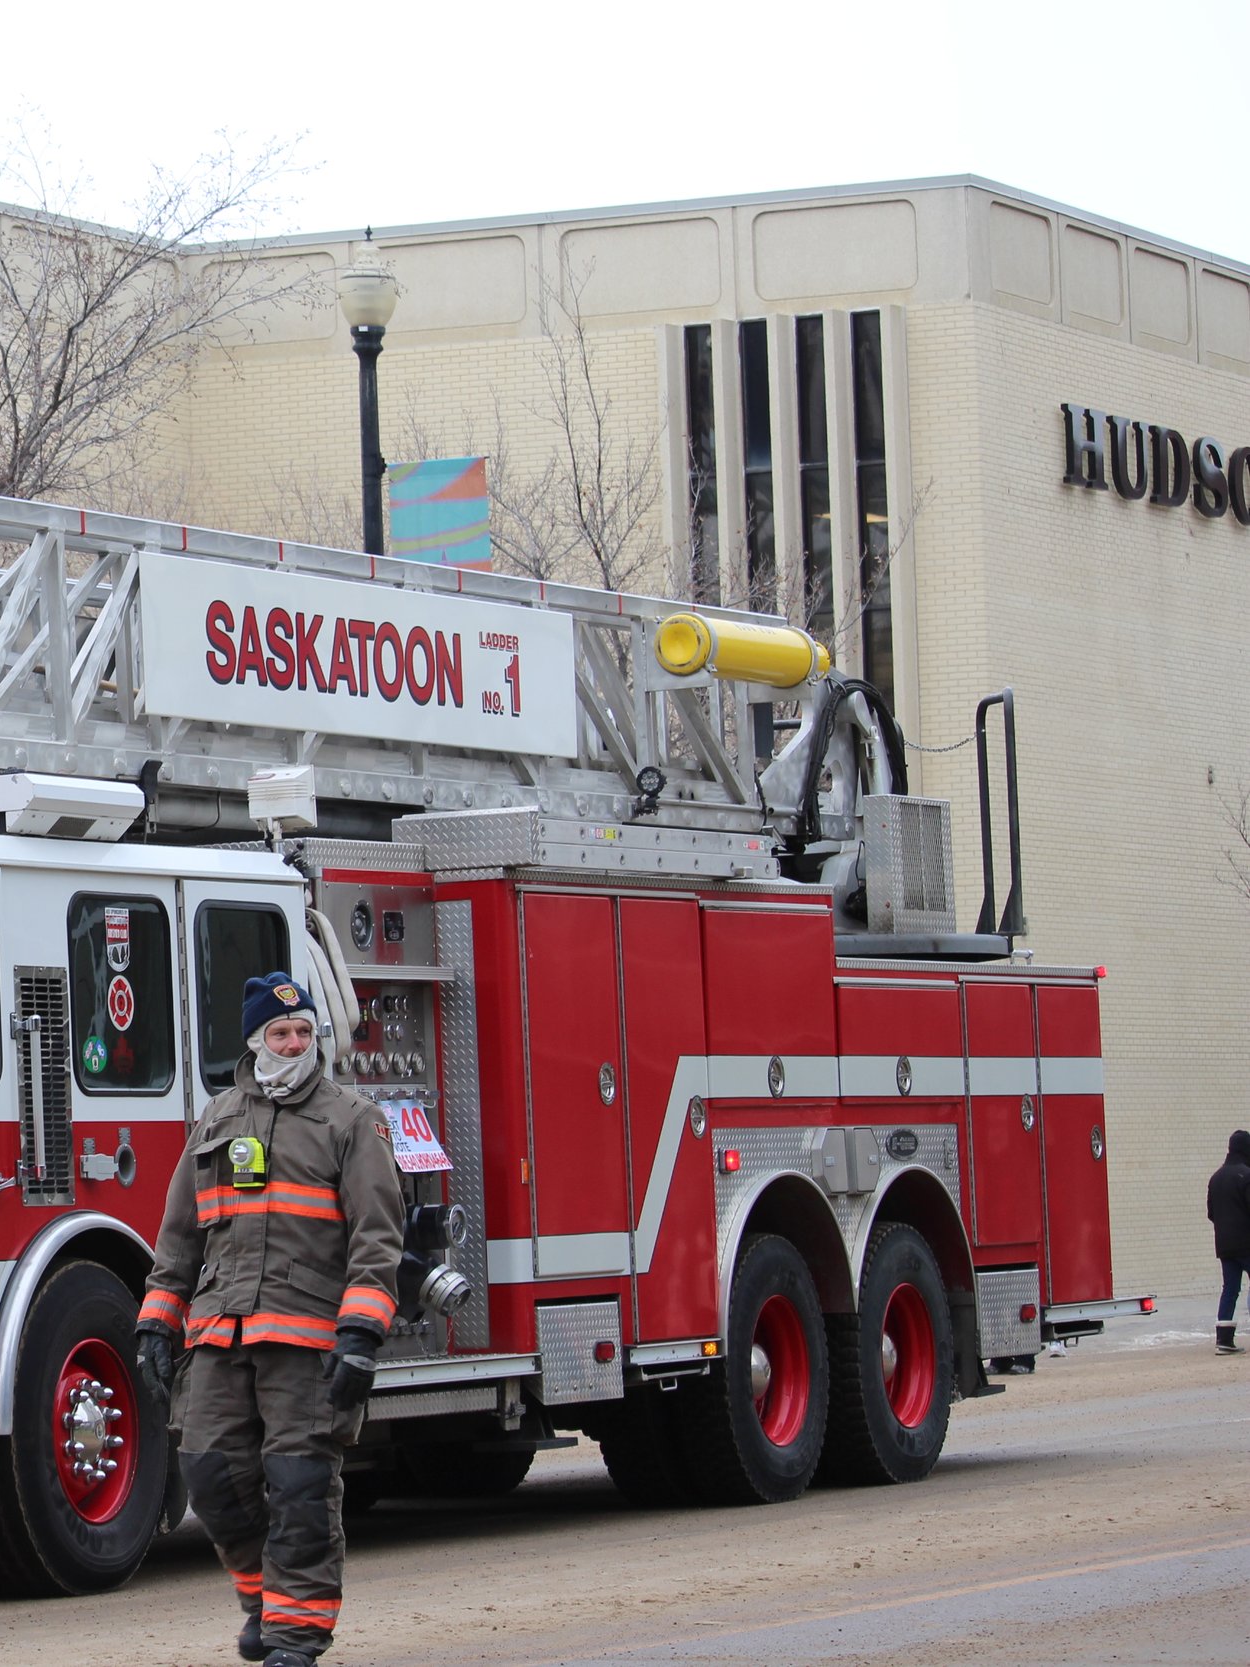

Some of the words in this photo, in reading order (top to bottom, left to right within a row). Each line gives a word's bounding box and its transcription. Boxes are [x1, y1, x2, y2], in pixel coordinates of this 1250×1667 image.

[205, 600, 464, 708] SASKATOON
[478, 631, 520, 652] LADDER
[481, 690, 505, 715] NO.
[504, 654, 521, 717] 1
[401, 1106, 433, 1143] 40
